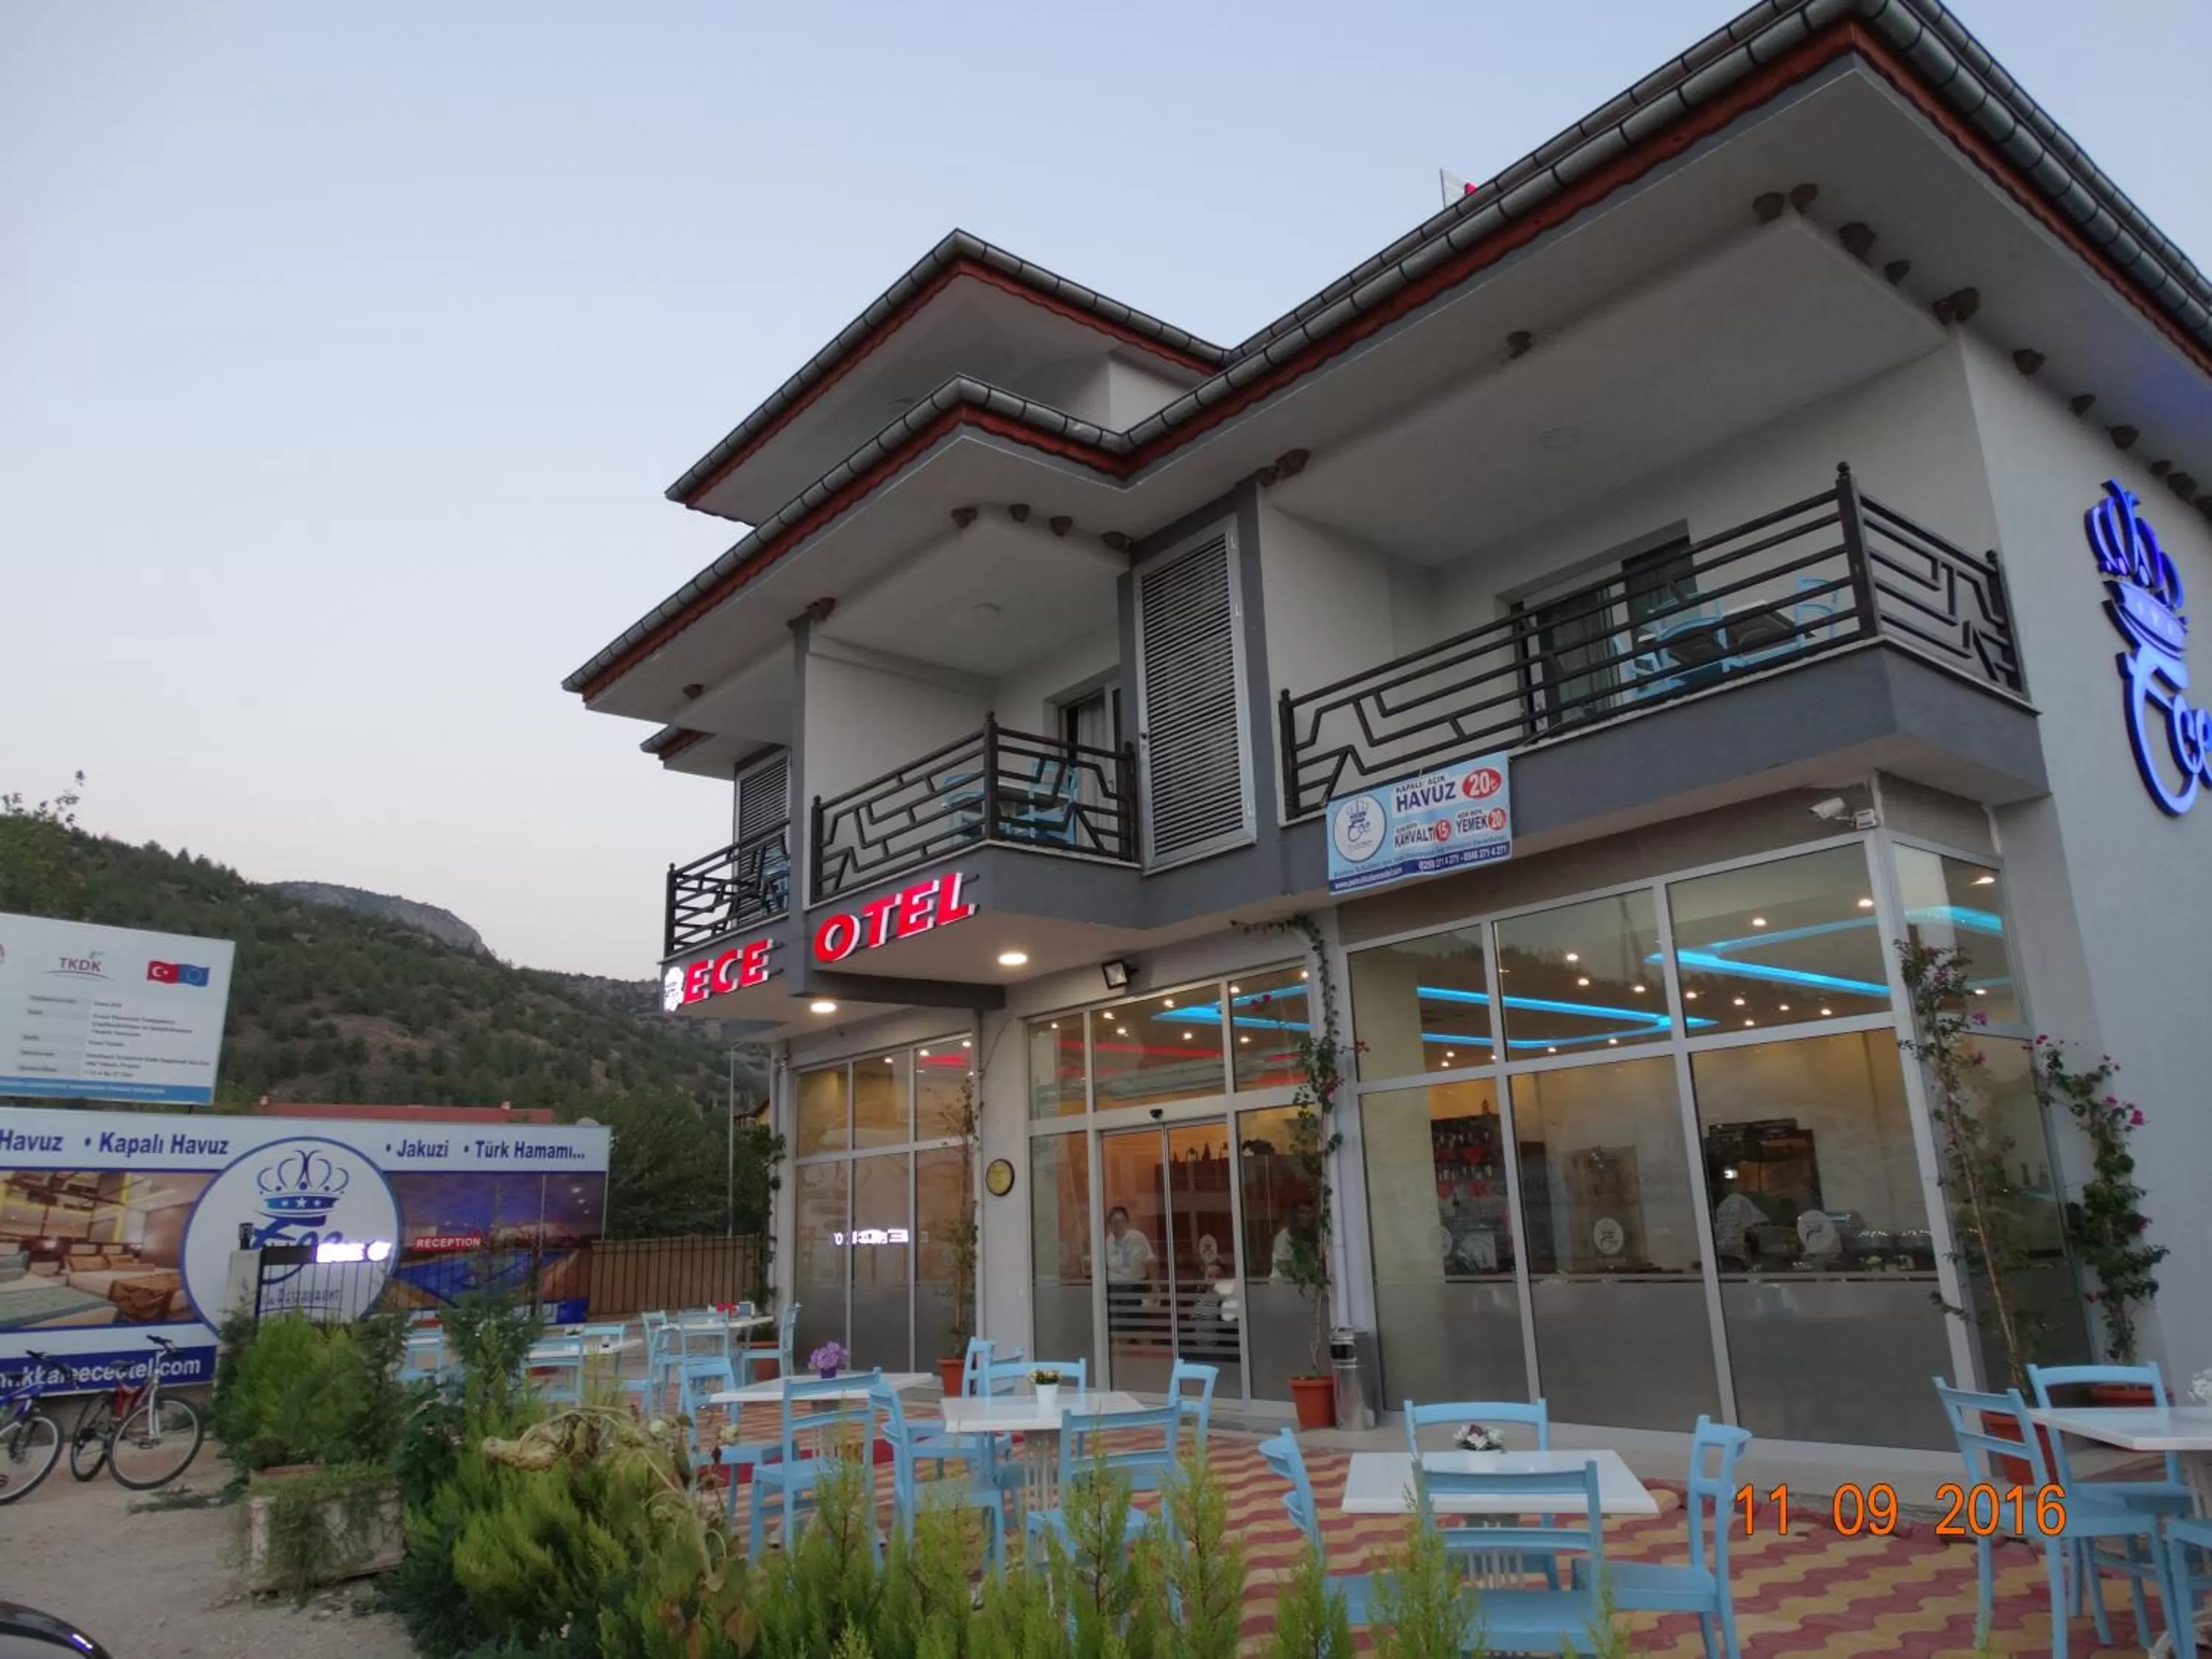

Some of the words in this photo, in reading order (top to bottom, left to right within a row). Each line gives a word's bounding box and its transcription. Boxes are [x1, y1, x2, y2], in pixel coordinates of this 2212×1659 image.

[1397, 782, 1456, 813] HAVUZ
[1456, 814, 1488, 834] YEMEK
[683, 939, 773, 1005] ECE
[814, 872, 978, 963] OTEL
[59, 957, 102, 972] TKDK
[0, 1129, 63, 1152] Havuz
[99, 1132, 164, 1158] Kapalı
[170, 1134, 229, 1155] Havuz
[397, 1139, 448, 1158] Jakuzi
[475, 1141, 509, 1158] Türk
[514, 1141, 585, 1159] Hamamı...
[416, 1237, 481, 1249] RECEPTION
